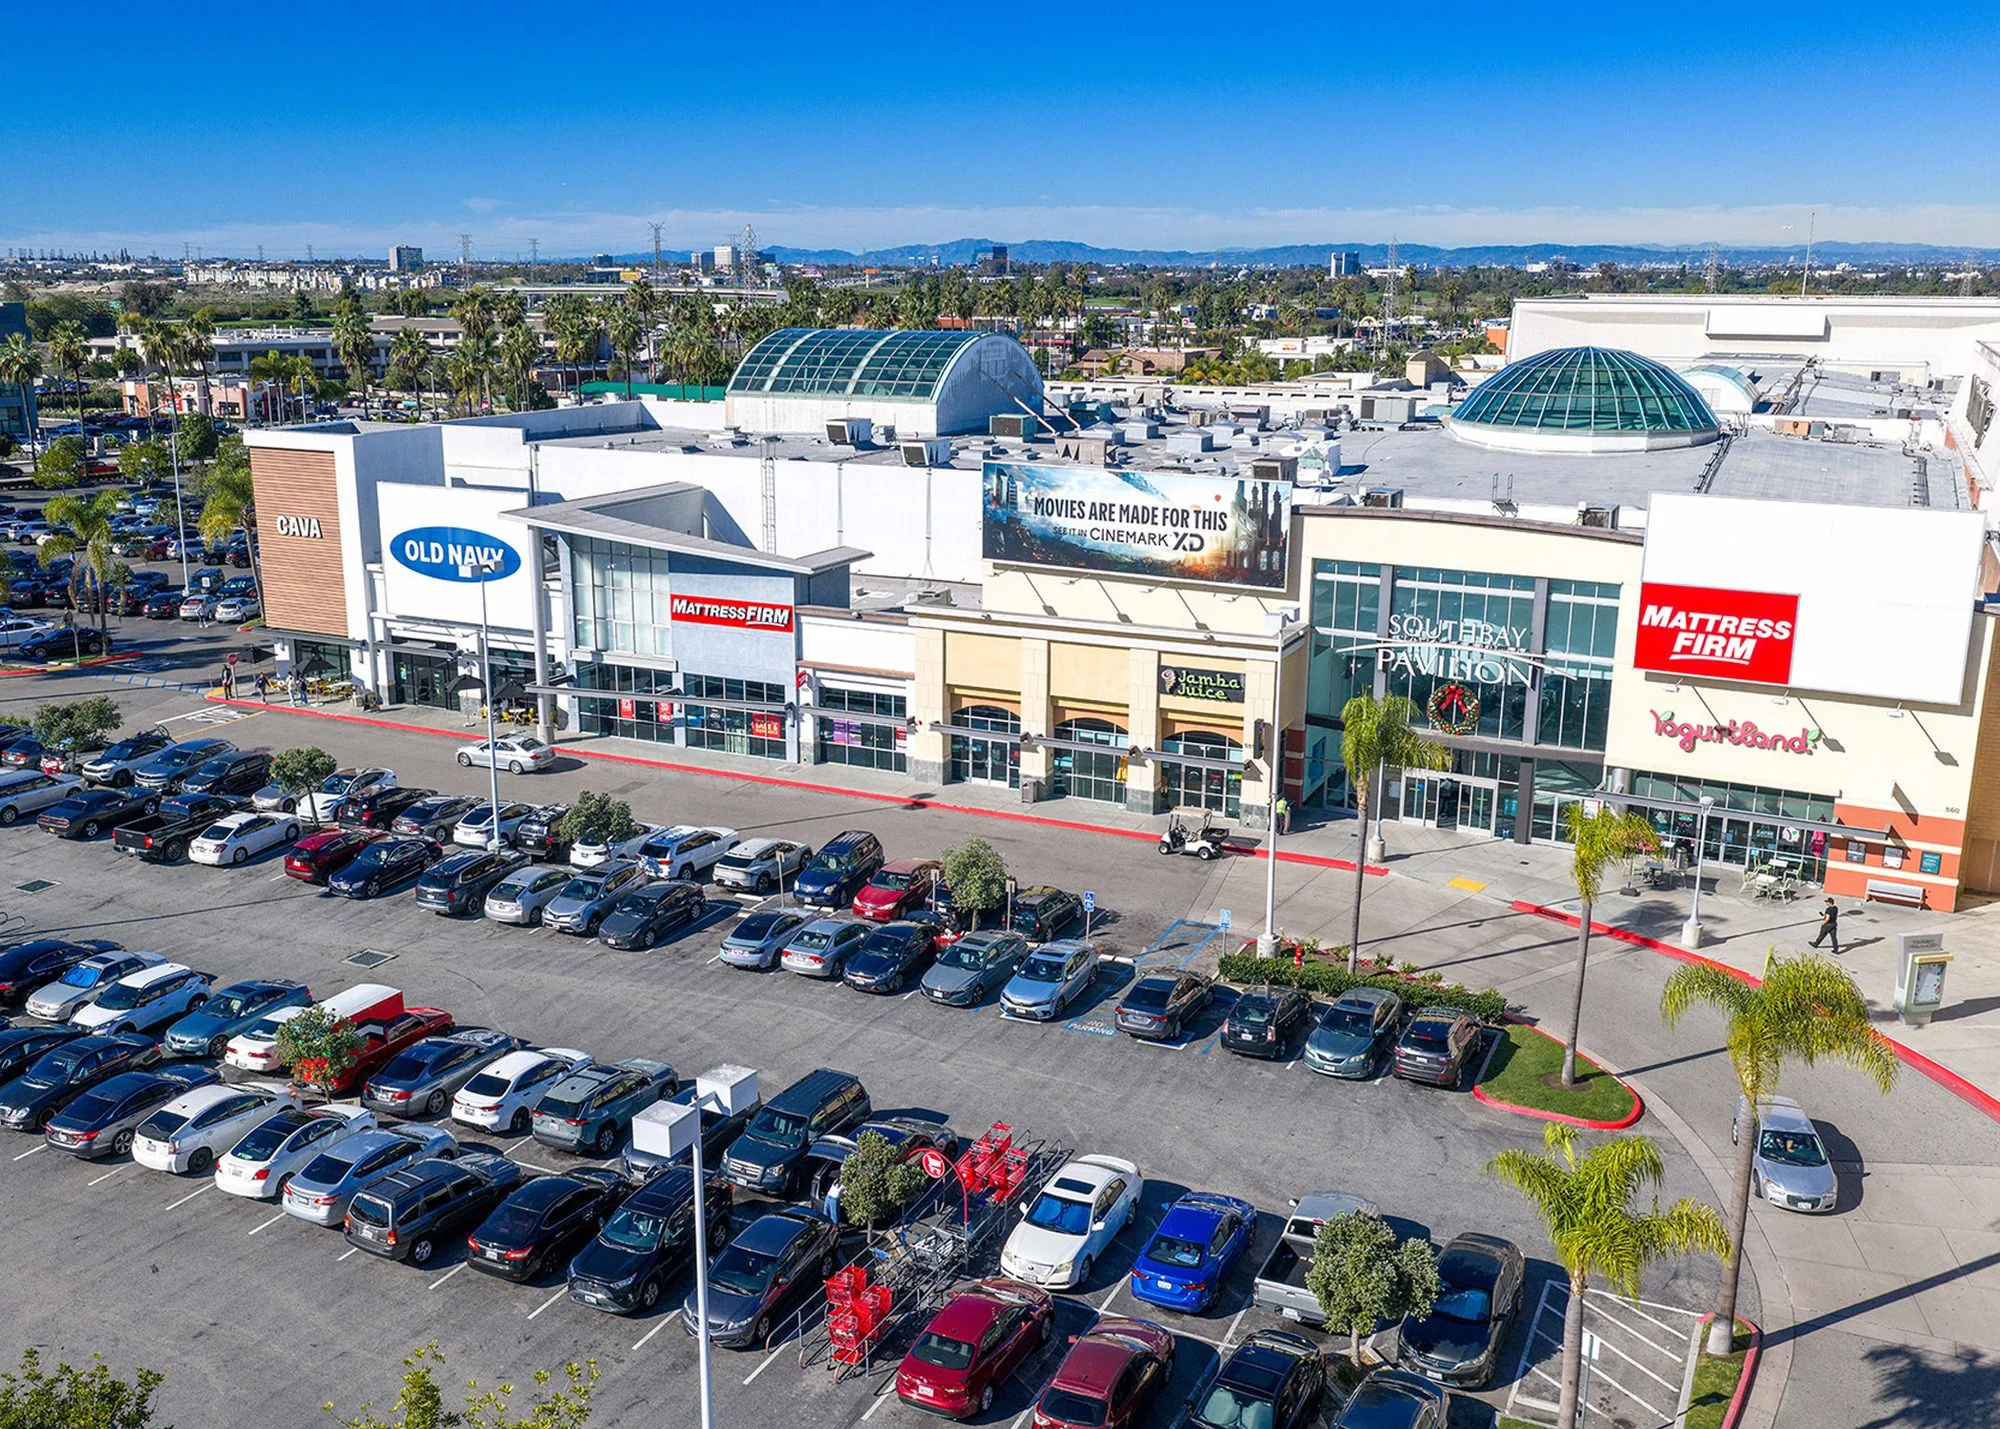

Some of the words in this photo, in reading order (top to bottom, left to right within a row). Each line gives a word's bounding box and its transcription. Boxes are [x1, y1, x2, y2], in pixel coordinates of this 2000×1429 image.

[276, 514, 323, 539] CAVA
[1034, 497, 1085, 521] MOVIES
[1088, 501, 1116, 522] ARE
[1119, 502, 1158, 526] MADE
[1162, 507, 1189, 528] FOR
[1193, 509, 1228, 532] THIS
[404, 539, 444, 564] OLD
[447, 543, 504, 567] NAVY
[1052, 527, 1067, 536] SEE
[1068, 528, 1076, 537] IT
[1078, 528, 1087, 537] IN
[1090, 527, 1169, 547] CINEMARK
[1172, 531, 1205, 552] XD
[1389, 614, 1528, 648] SOUTHBAY
[1641, 604, 1792, 641] MATTRESS
[1672, 631, 1757, 660] FIRM
[1177, 670, 1240, 689] Jamba
[1376, 648, 1536, 691] PAVILION
[1177, 683, 1228, 699] Juice
[1650, 709, 1813, 755] Yogurtland
[1068, 1023, 1115, 1035] PARKING
